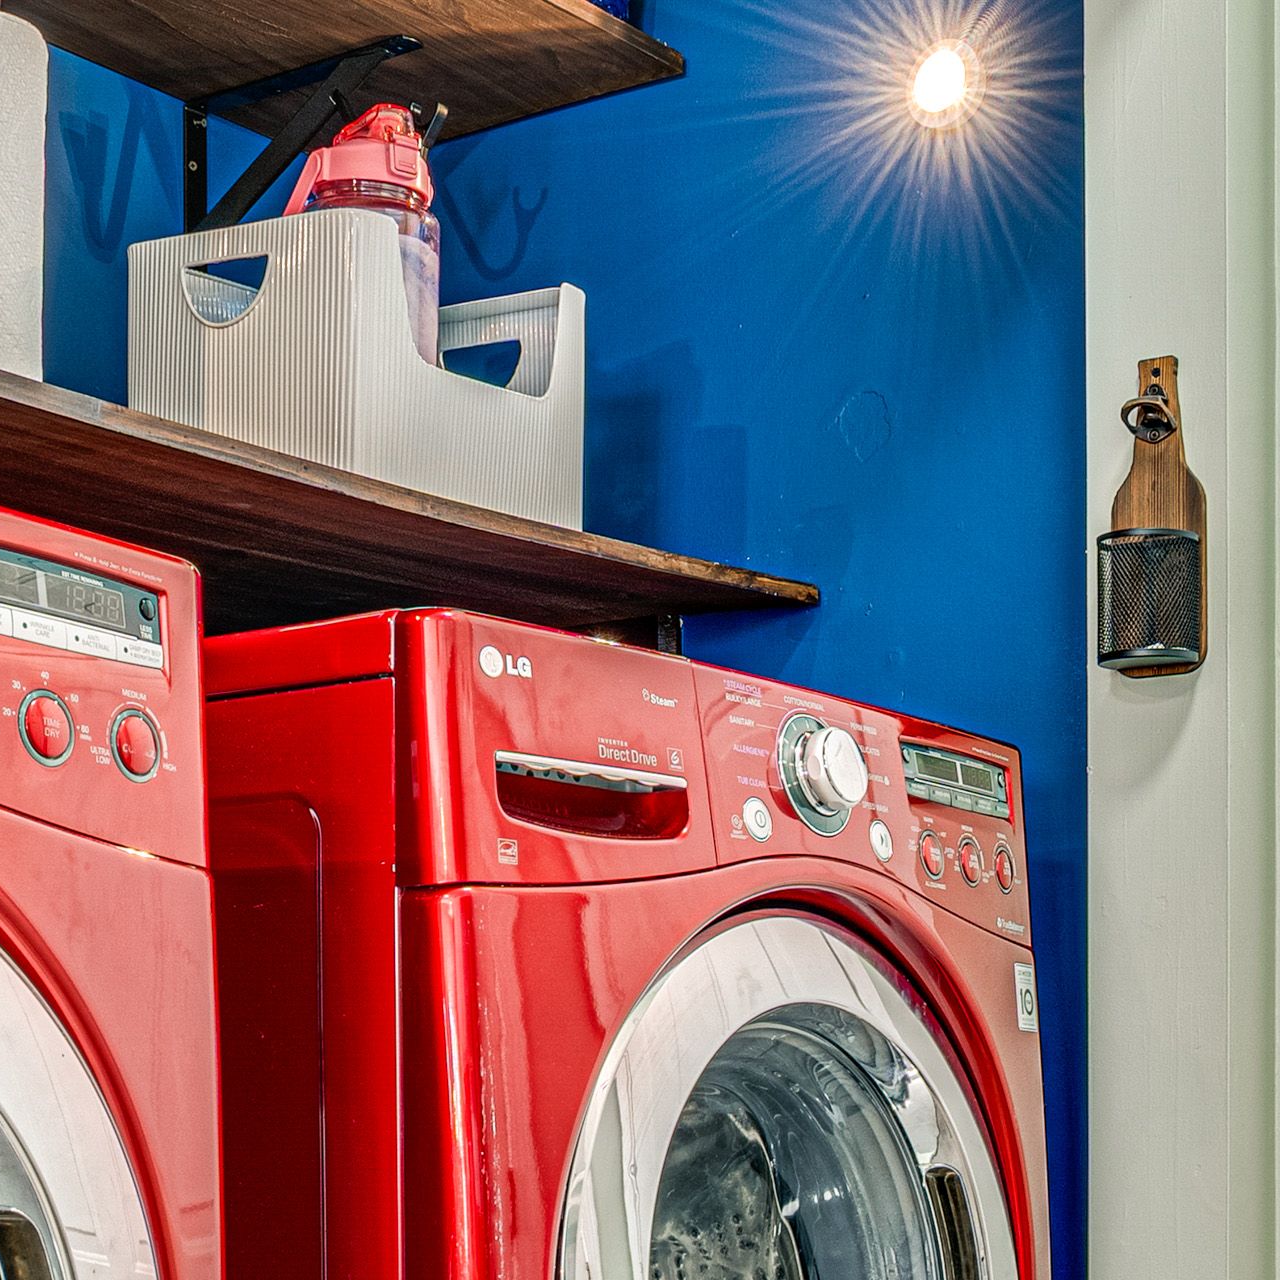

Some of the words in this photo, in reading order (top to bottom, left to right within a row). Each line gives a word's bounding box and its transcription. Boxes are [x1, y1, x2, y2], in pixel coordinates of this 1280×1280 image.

[506, 654, 533, 678] LG
[121, 688, 147, 701] MEDIUM
[90, 745, 110, 756] ULTRA
[95, 755, 110, 765] LOW
